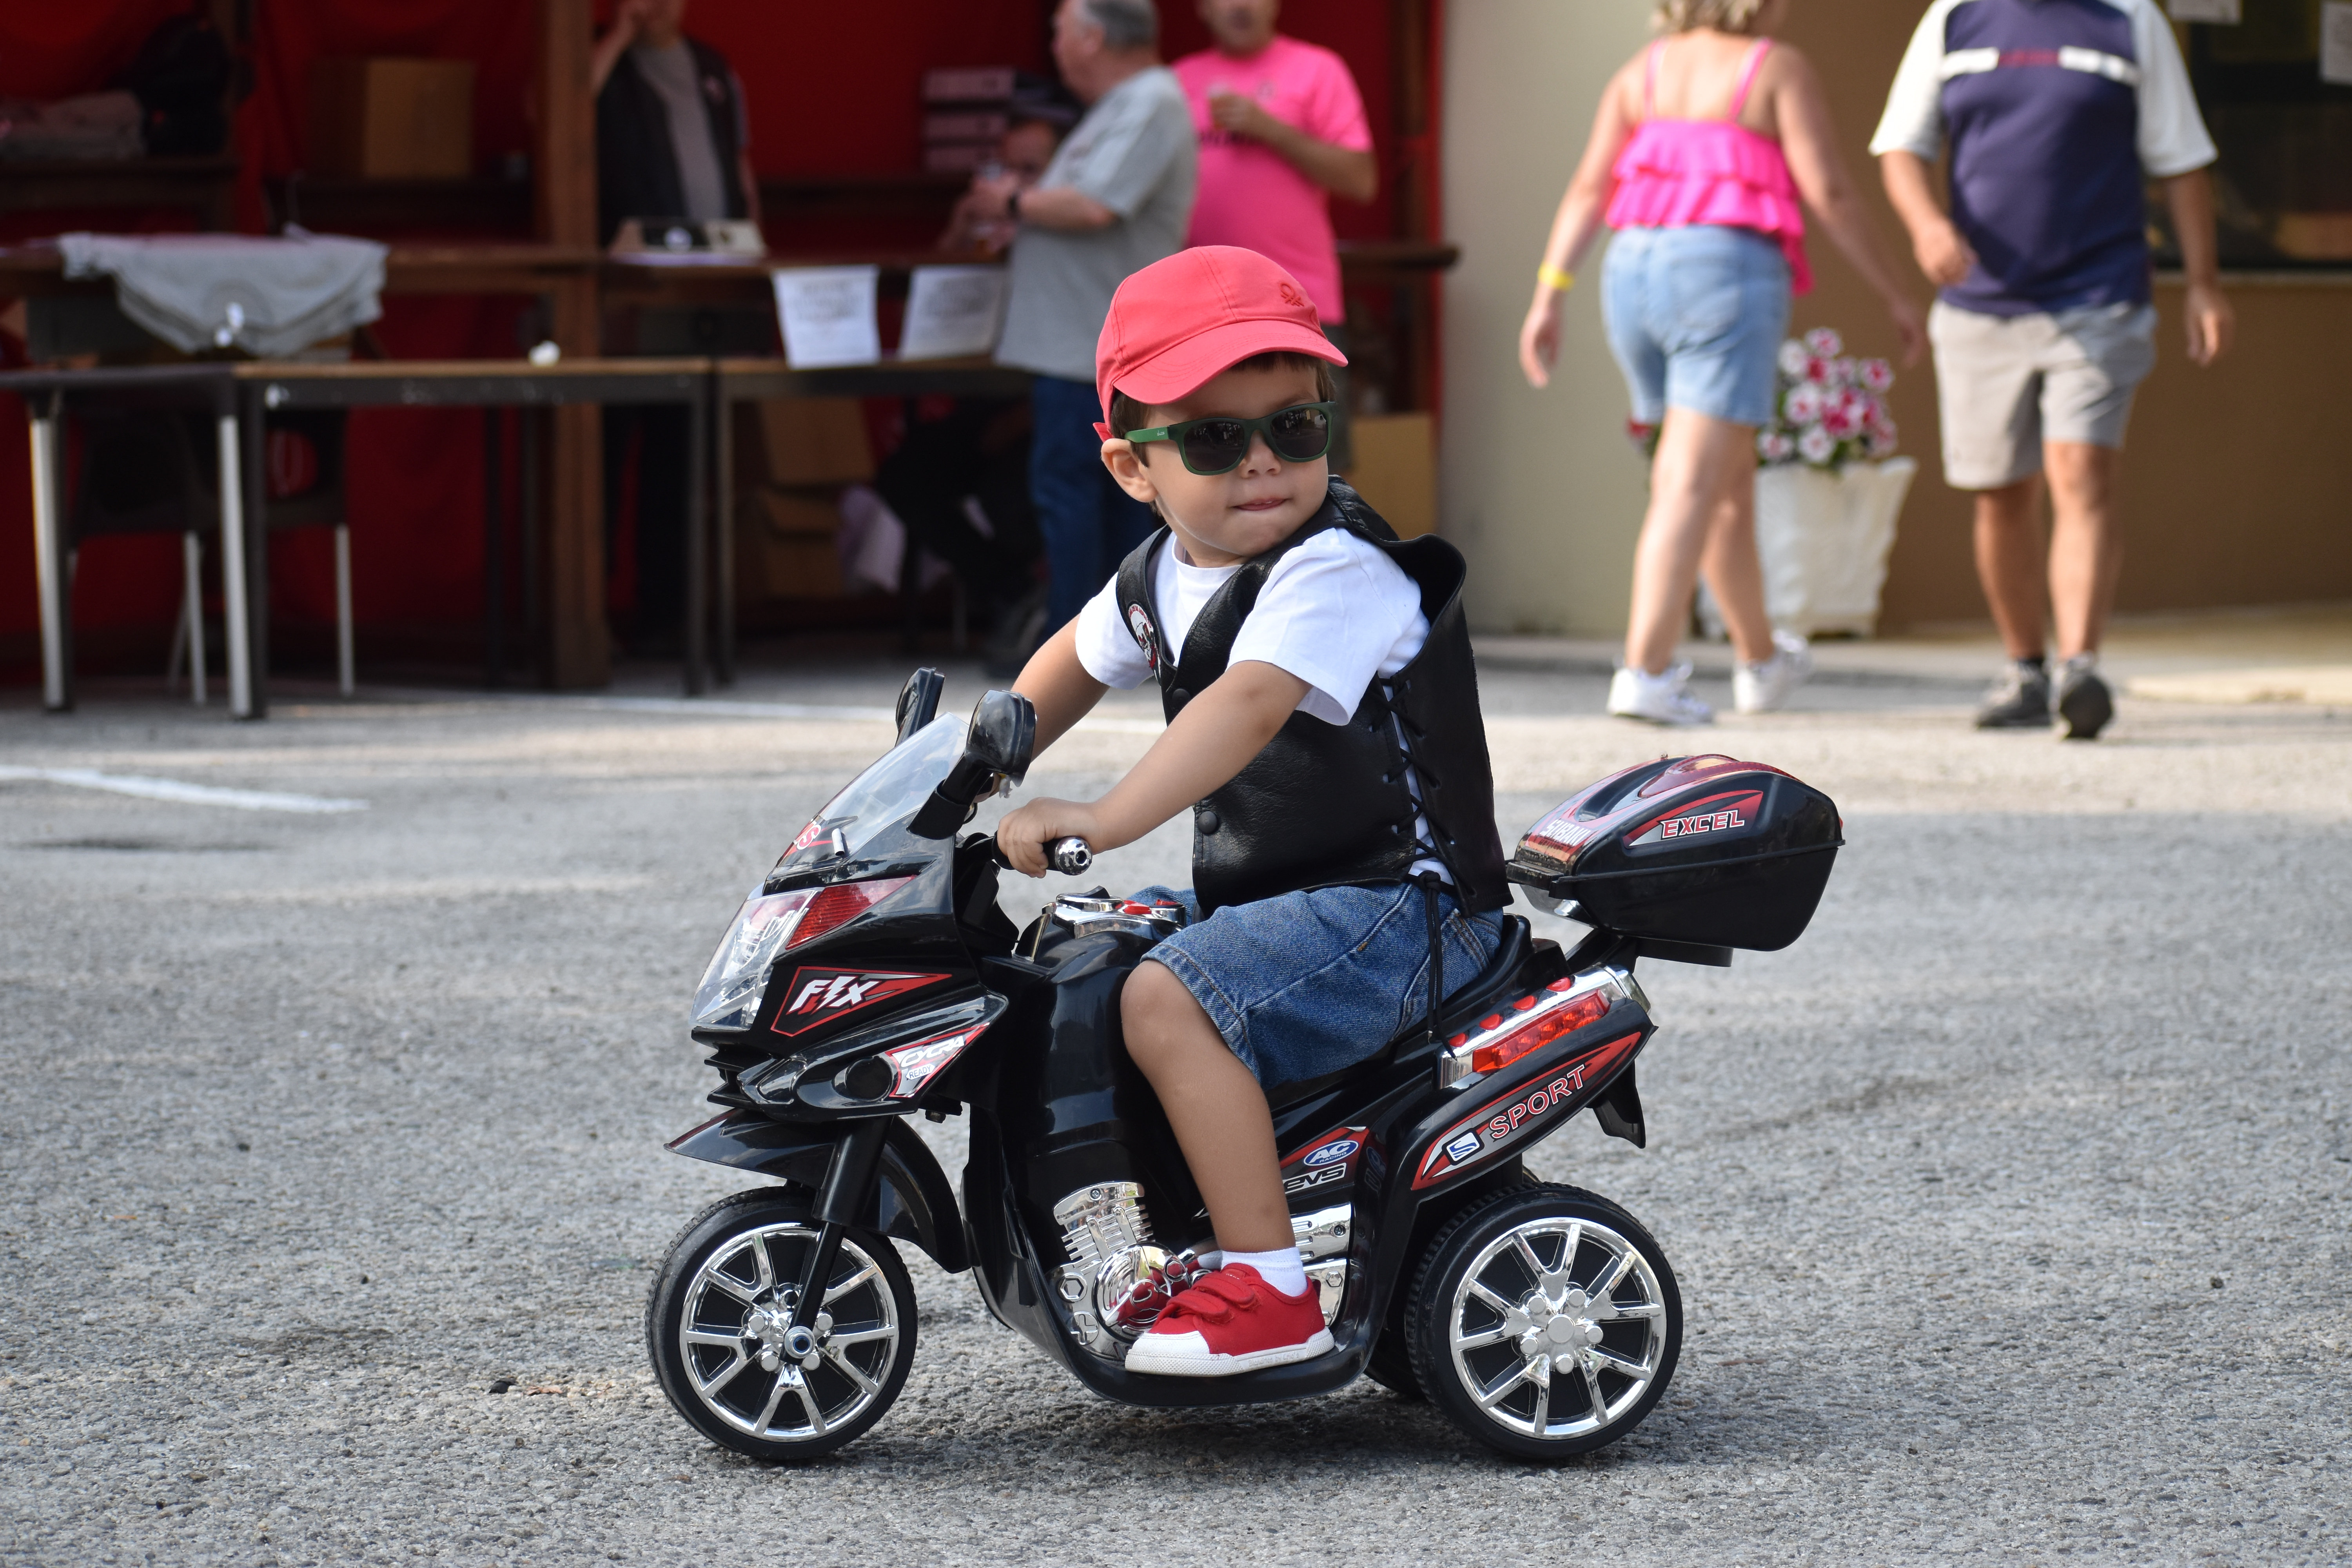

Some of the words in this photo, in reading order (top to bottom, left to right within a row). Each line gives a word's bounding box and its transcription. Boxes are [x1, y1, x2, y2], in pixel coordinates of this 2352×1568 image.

[1660, 809, 1745, 838] EXCEL
[786, 976, 881, 1014] FIX
[901, 1035, 964, 1067] CYCRA
[909, 1065, 932, 1079] READY
[1489, 1064, 1585, 1139] SPORT
[1308, 1142, 1351, 1164] AC
[1319, 1152, 1347, 1163] RACING
